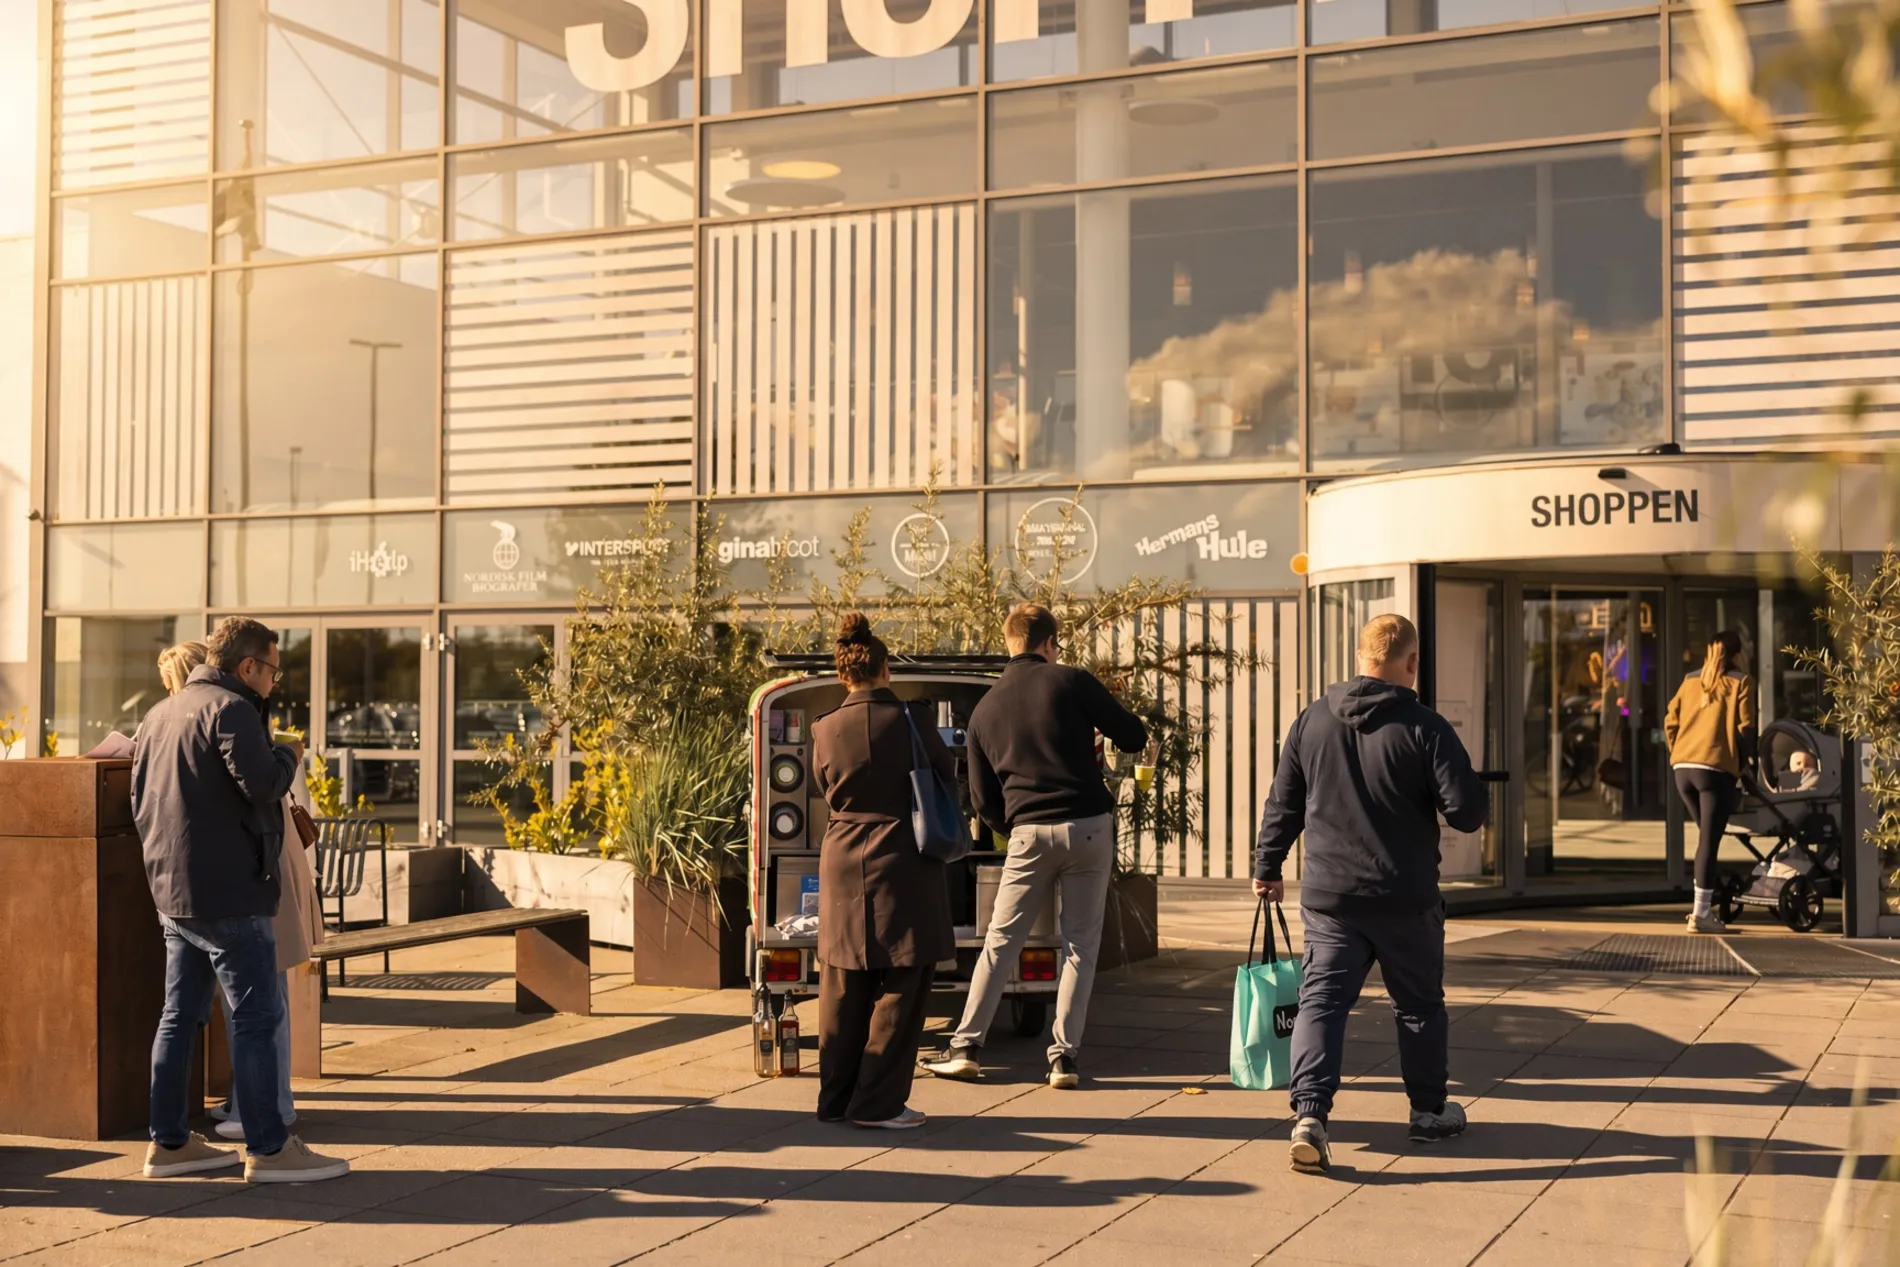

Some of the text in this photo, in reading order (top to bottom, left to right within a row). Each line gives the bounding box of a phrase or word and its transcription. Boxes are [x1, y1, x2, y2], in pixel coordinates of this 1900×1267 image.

[1531, 489, 1699, 527] SHOPPEN
[579, 538, 670, 556] INTERSPO
[718, 535, 820, 563] ginabcot
[1134, 513, 1220, 556] Hermans
[1196, 529, 1268, 561] Hule
